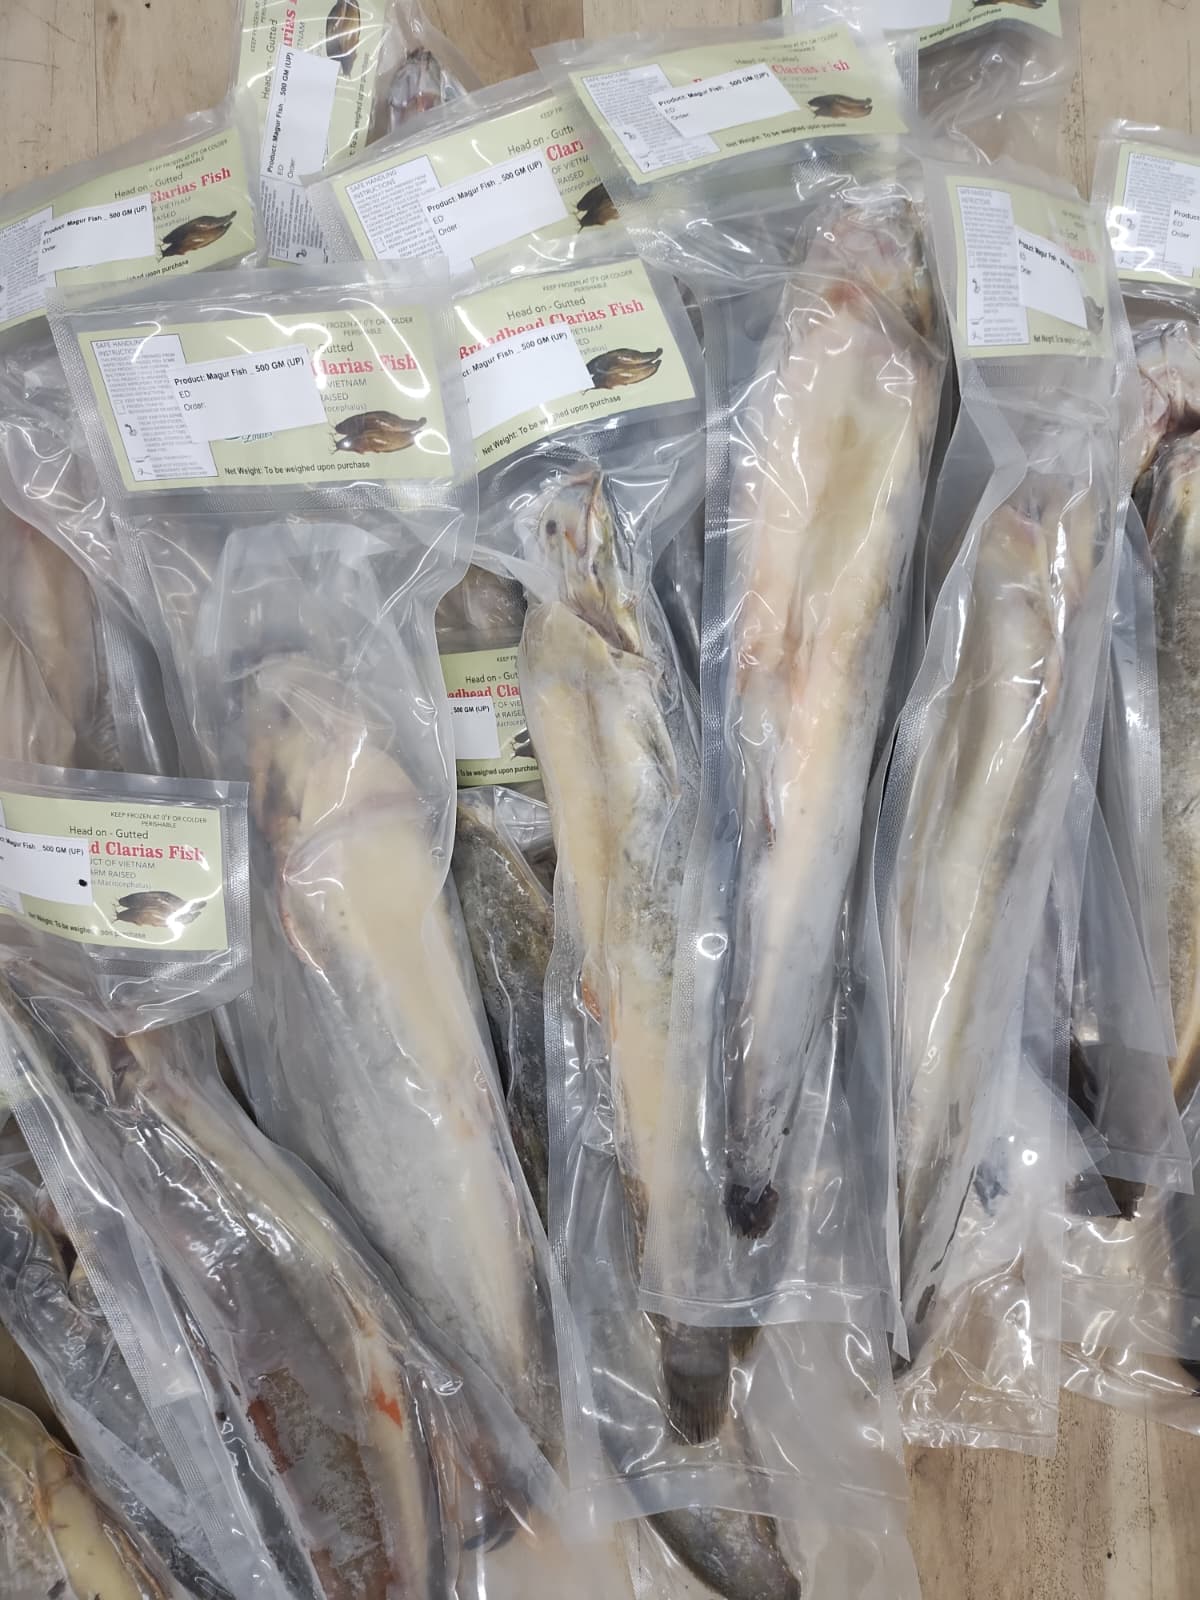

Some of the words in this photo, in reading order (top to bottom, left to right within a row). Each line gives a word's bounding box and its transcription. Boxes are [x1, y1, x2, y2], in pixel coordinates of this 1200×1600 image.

[266, 19, 278, 53] Gutted
[281, 9, 296, 47] rias
[285, 52, 294, 69] (UP)
[282, 69, 289, 82] GM
[263, 75, 272, 100] Head
[280, 83, 288, 96] 500
[688, 90, 708, 99] Magur
[276, 103, 284, 119] Fish
[272, 118, 281, 141] Magur
[507, 140, 532, 155] Head
[532, 137, 544, 147] on
[551, 125, 575, 140] Gutt
[267, 143, 277, 173] Product:
[546, 139, 584, 161] Clar
[552, 164, 563, 175] OF
[563, 155, 590, 171] VIETNA
[201, 167, 231, 187] Fish
[558, 170, 584, 185] RAISED
[114, 186, 136, 199] Head
[138, 184, 148, 193] on
[155, 172, 184, 188] Gutted
[427, 196, 456, 213] Product:
[457, 187, 479, 201] Magur
[480, 180, 496, 191] Fish
[501, 171, 514, 182] 500
[515, 167, 527, 178] GM
[527, 160, 543, 173] (UP)
[67, 218, 86, 227] Magur
[134, 205, 147, 215] (UP)
[433, 215, 444, 225] ED
[162, 260, 189, 274] purchase
[542, 284, 557, 292] KEEP
[557, 280, 581, 290] FROZEN
[610, 270, 633, 280] COLDER
[574, 283, 608, 293] PERISHABLE
[506, 305, 533, 321] Head
[536, 303, 548, 313] on
[553, 297, 586, 311] Gutted
[607, 299, 644, 318] Fish
[113, 340, 143, 348] HANDLIN
[472, 358, 496, 372] Magur
[497, 348, 514, 360] Fish
[521, 340, 536, 350] 500
[537, 335, 550, 346] GM
[550, 332, 568, 344] (UP)
[174, 375, 206, 386] Product:
[206, 371, 230, 382] Magur
[231, 367, 248, 377] Fish
[255, 363, 270, 373] 500
[271, 359, 285, 370] GM
[286, 356, 304, 369] (UP)
[327, 379, 368, 389] VIETNAM
[179, 390, 191, 399] ED
[481, 445, 493, 456] Net
[493, 430, 519, 448] Weight:
[519, 426, 529, 435] To
[529, 421, 538, 431] be
[570, 403, 589, 415] upon
[590, 394, 621, 410] purchase
[224, 467, 238, 475] Net
[238, 465, 263, 476] Weight:
[264, 465, 273, 474] To
[274, 465, 284, 474] be
[285, 462, 315, 475] weighed
[317, 463, 336, 473] upon
[337, 460, 370, 471] purchase
[465, 675, 485, 684] Head
[475, 705, 490, 713] (UP)
[501, 709, 523, 718] RAISE
[473, 767, 496, 777] weighed
[498, 767, 513, 775] upon
[514, 764, 539, 773] purchase
[127, 812, 151, 820] FROZEN
[182, 816, 207, 824] COLDER
[141, 820, 177, 828] PERISHABLE
[69, 826, 93, 836] Head
[95, 829, 107, 837] on
[115, 829, 149, 840] Gutted
[22, 841, 36, 850] Fish
[42, 845, 55, 853] 500
[68, 847, 84, 856] (UP)
[105, 841, 163, 859] Clarias
[168, 845, 204, 862] Fish
[105, 859, 117, 867] OF
[119, 861, 155, 869] VIETNAM
[108, 871, 136, 879] RAISED
[69, 924, 92, 935] weighe
